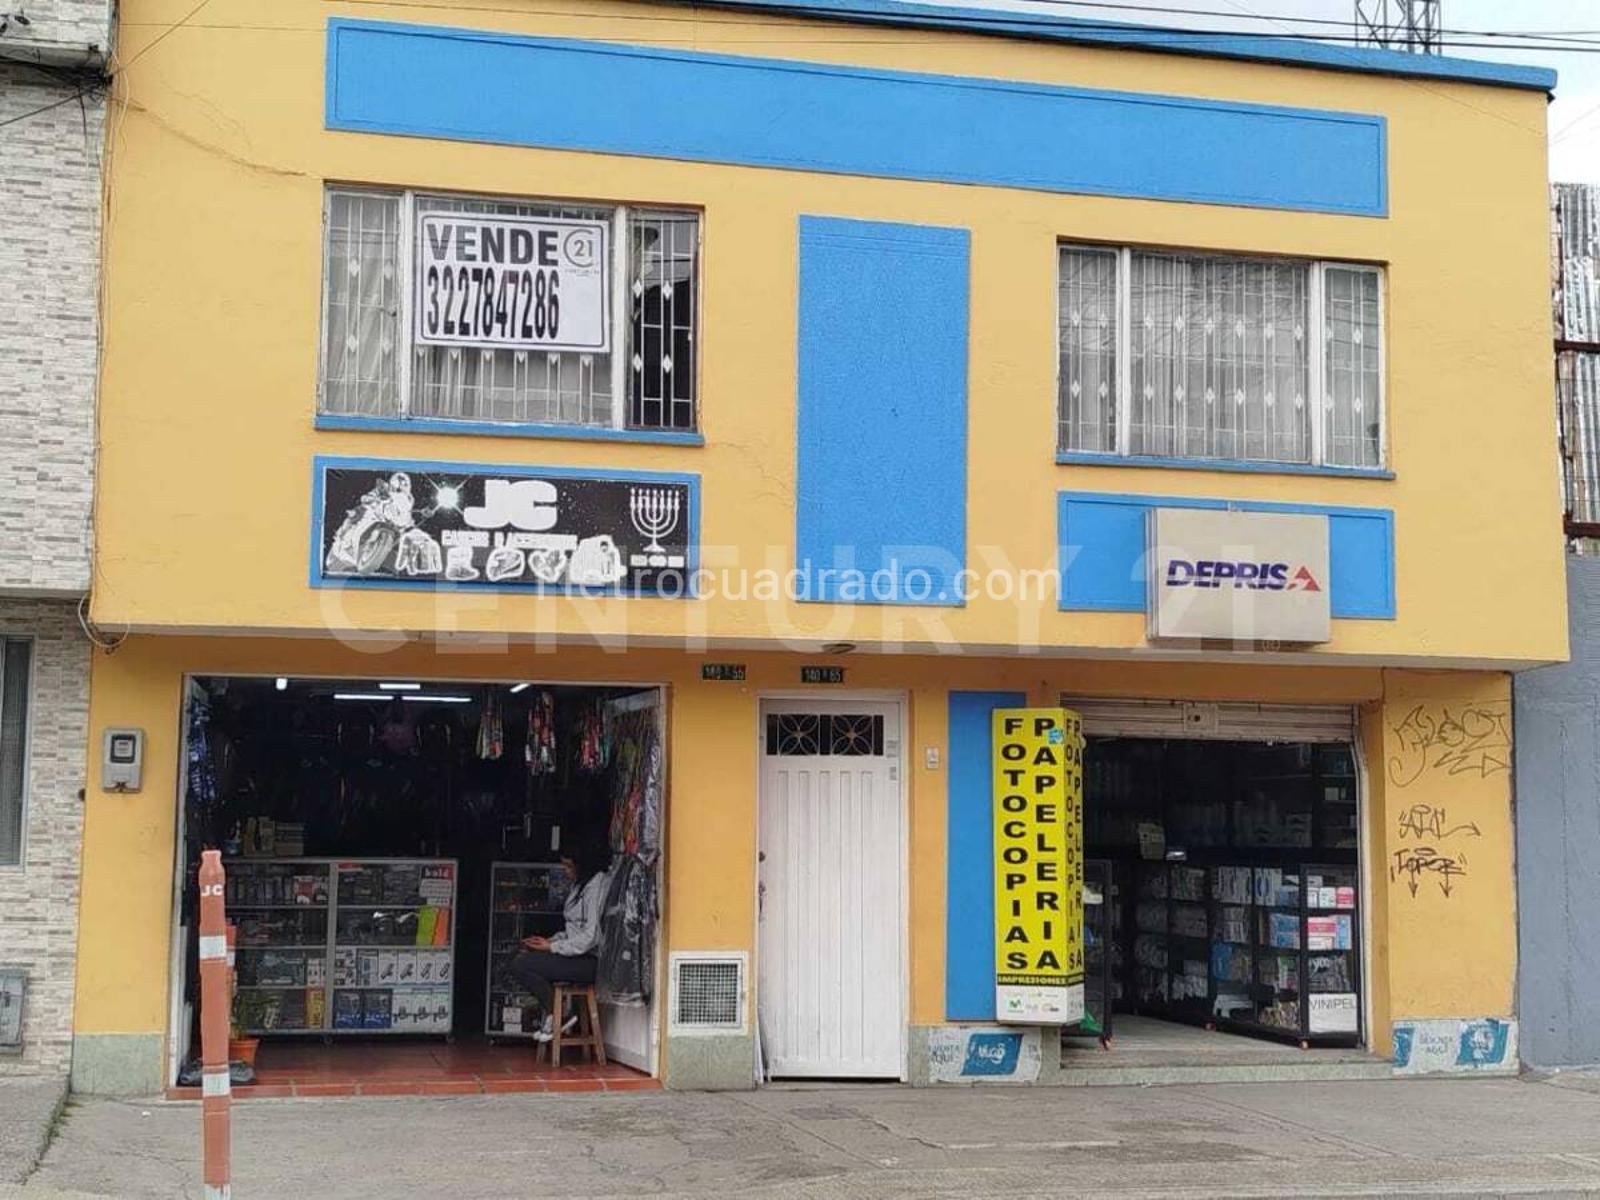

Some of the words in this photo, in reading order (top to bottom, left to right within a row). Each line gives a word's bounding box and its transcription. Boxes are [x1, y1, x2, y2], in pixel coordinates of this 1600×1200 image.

[426, 224, 559, 266] VENDE
[427, 266, 560, 340] 3227847286
[463, 479, 557, 530] JC
[1166, 559, 1289, 591] DEPRIS
[1002, 717, 1029, 970] FOTOCOPIAS
[1033, 717, 1060, 970] PAPELERIA
[201, 884, 224, 897] JC
